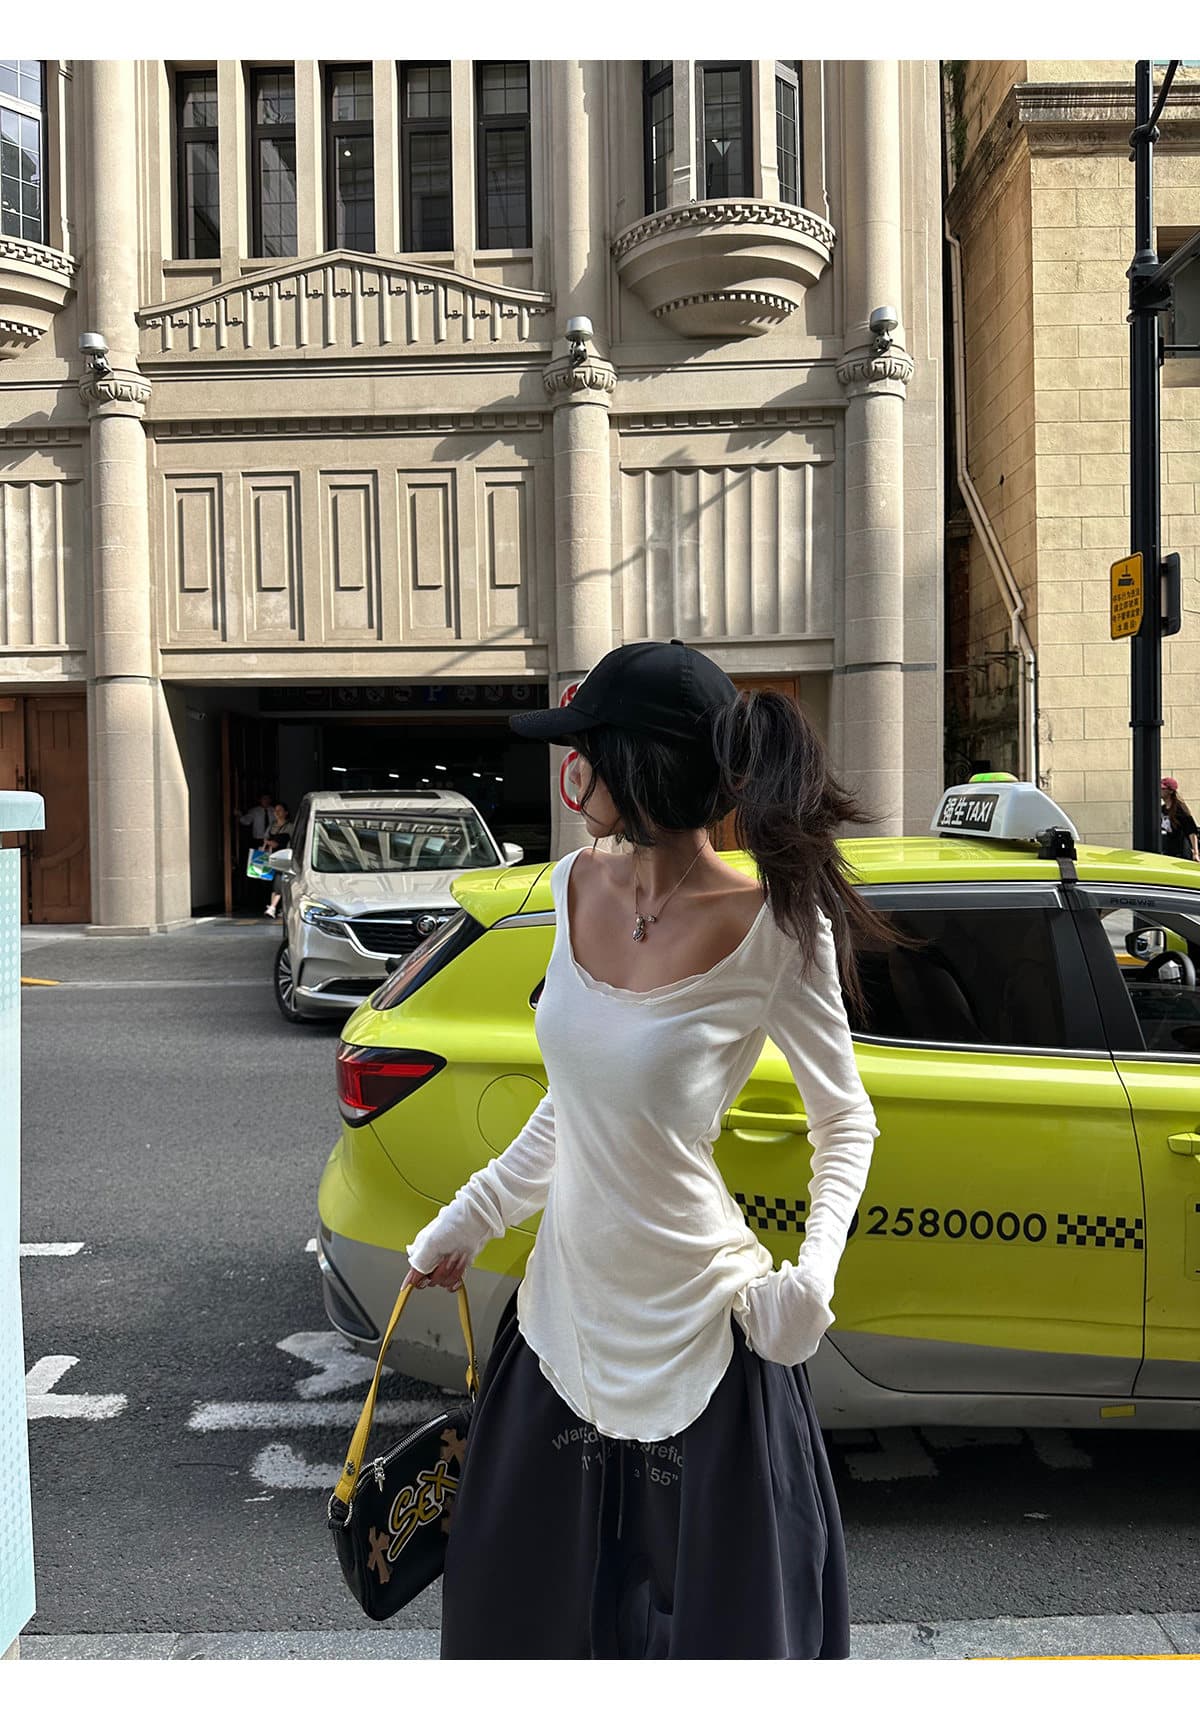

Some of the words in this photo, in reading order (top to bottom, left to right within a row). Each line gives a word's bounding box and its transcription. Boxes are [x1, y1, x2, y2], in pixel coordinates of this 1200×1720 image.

[941, 796, 968, 826] 强生
[965, 801, 993, 823] TAXI
[865, 1205, 1047, 1243] 2580000
[388, 1459, 459, 1562] SEX
